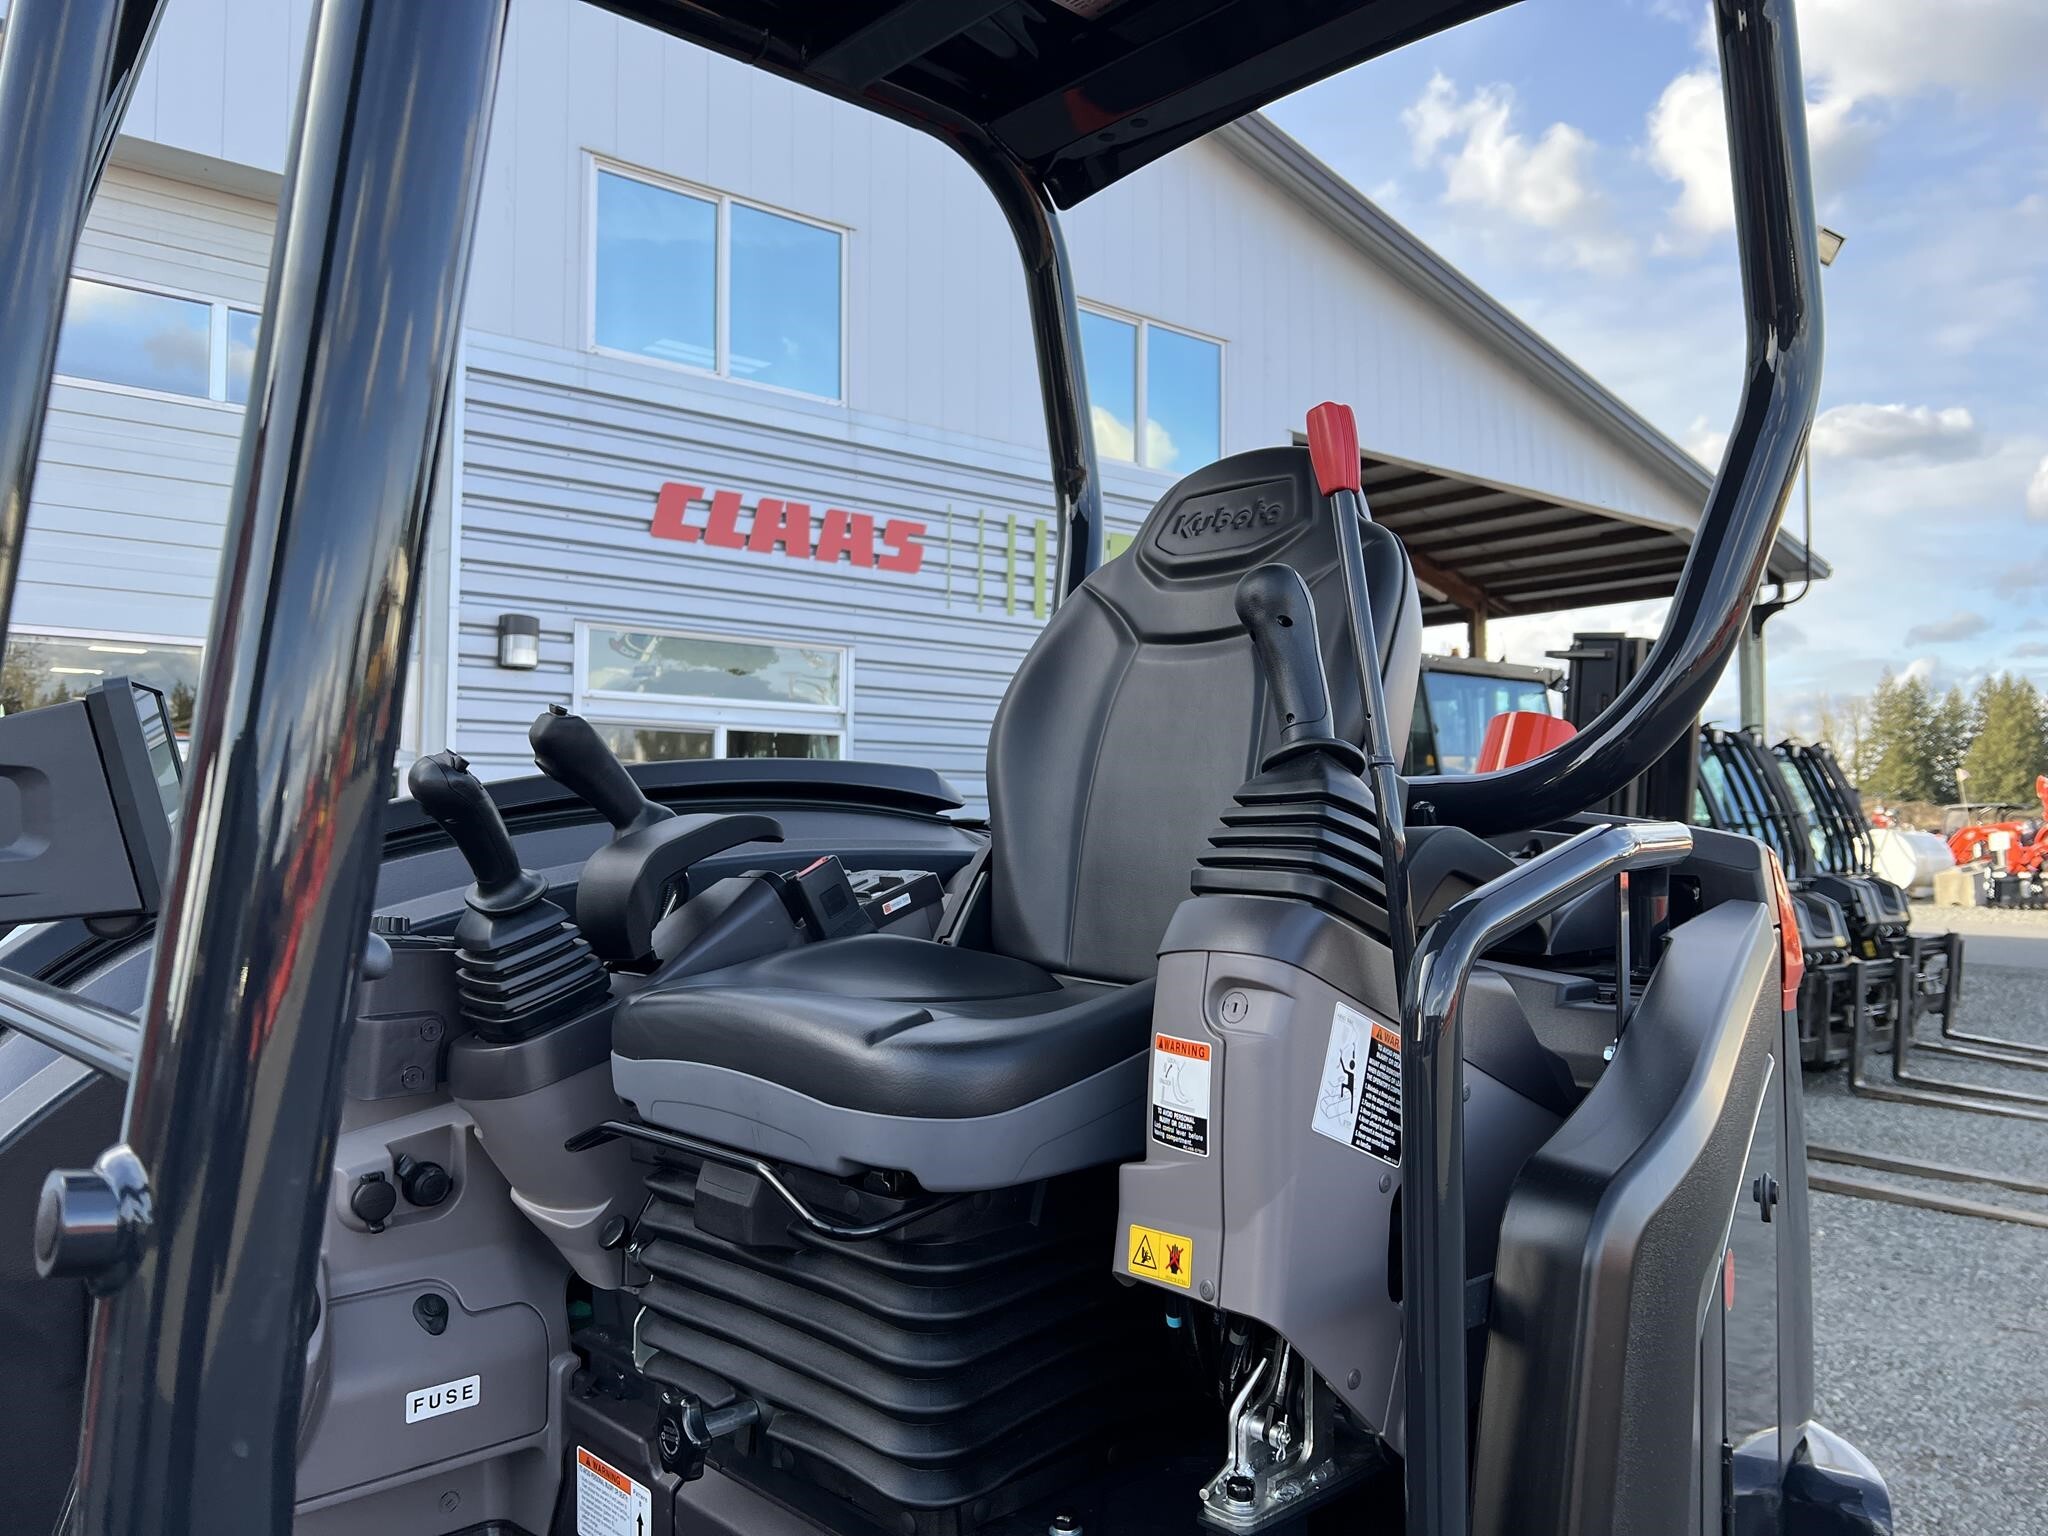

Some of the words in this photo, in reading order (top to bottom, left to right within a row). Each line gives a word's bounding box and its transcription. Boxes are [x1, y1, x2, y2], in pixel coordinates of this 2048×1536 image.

[651, 482, 927, 574] CLAAS
[1172, 498, 1282, 538] Kubota
[1165, 1040, 1204, 1057] WARNING
[1384, 1032, 1400, 1049] WAR
[414, 1384, 473, 1413] FUSE
[593, 1462, 620, 1485] WARNING
